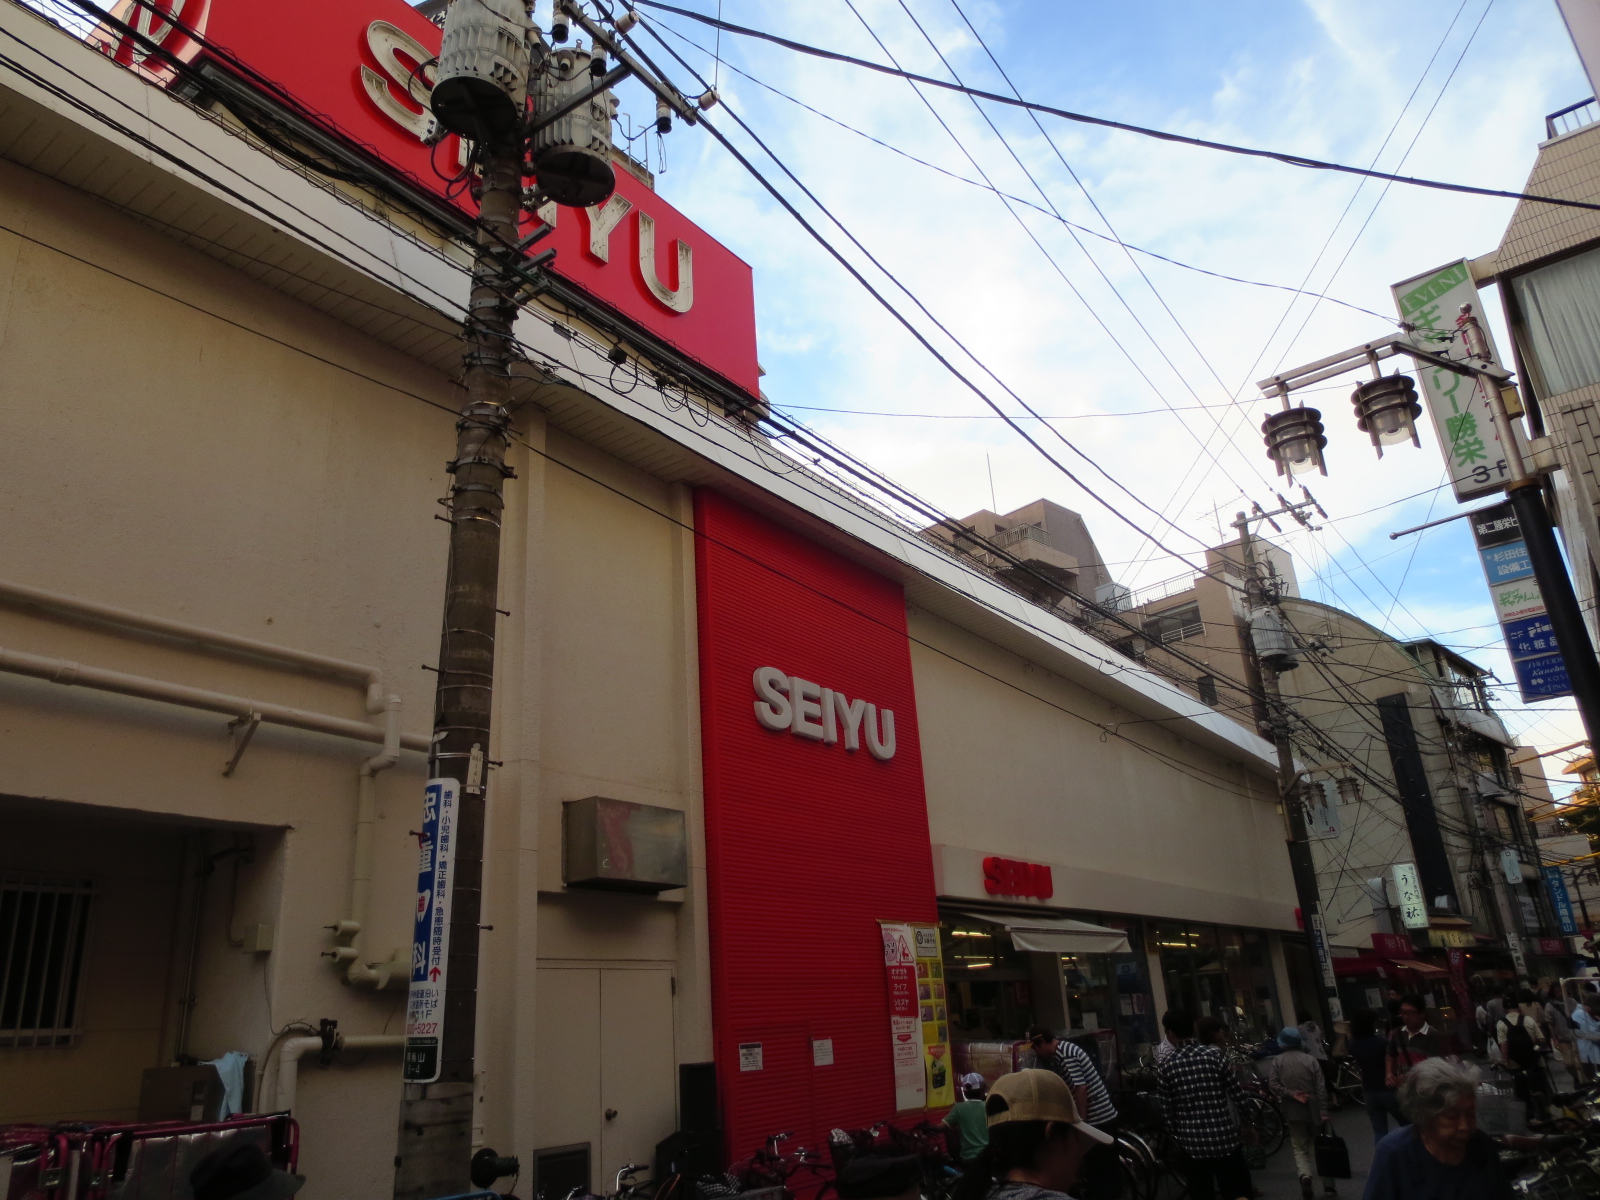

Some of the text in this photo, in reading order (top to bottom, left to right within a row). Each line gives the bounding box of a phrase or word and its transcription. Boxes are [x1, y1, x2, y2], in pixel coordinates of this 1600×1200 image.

[361, 20, 694, 313] SYU
[1402, 266, 1466, 312] EVENT
[1518, 637, 1560, 653] 化粧品
[753, 666, 896, 760] SEIYU
